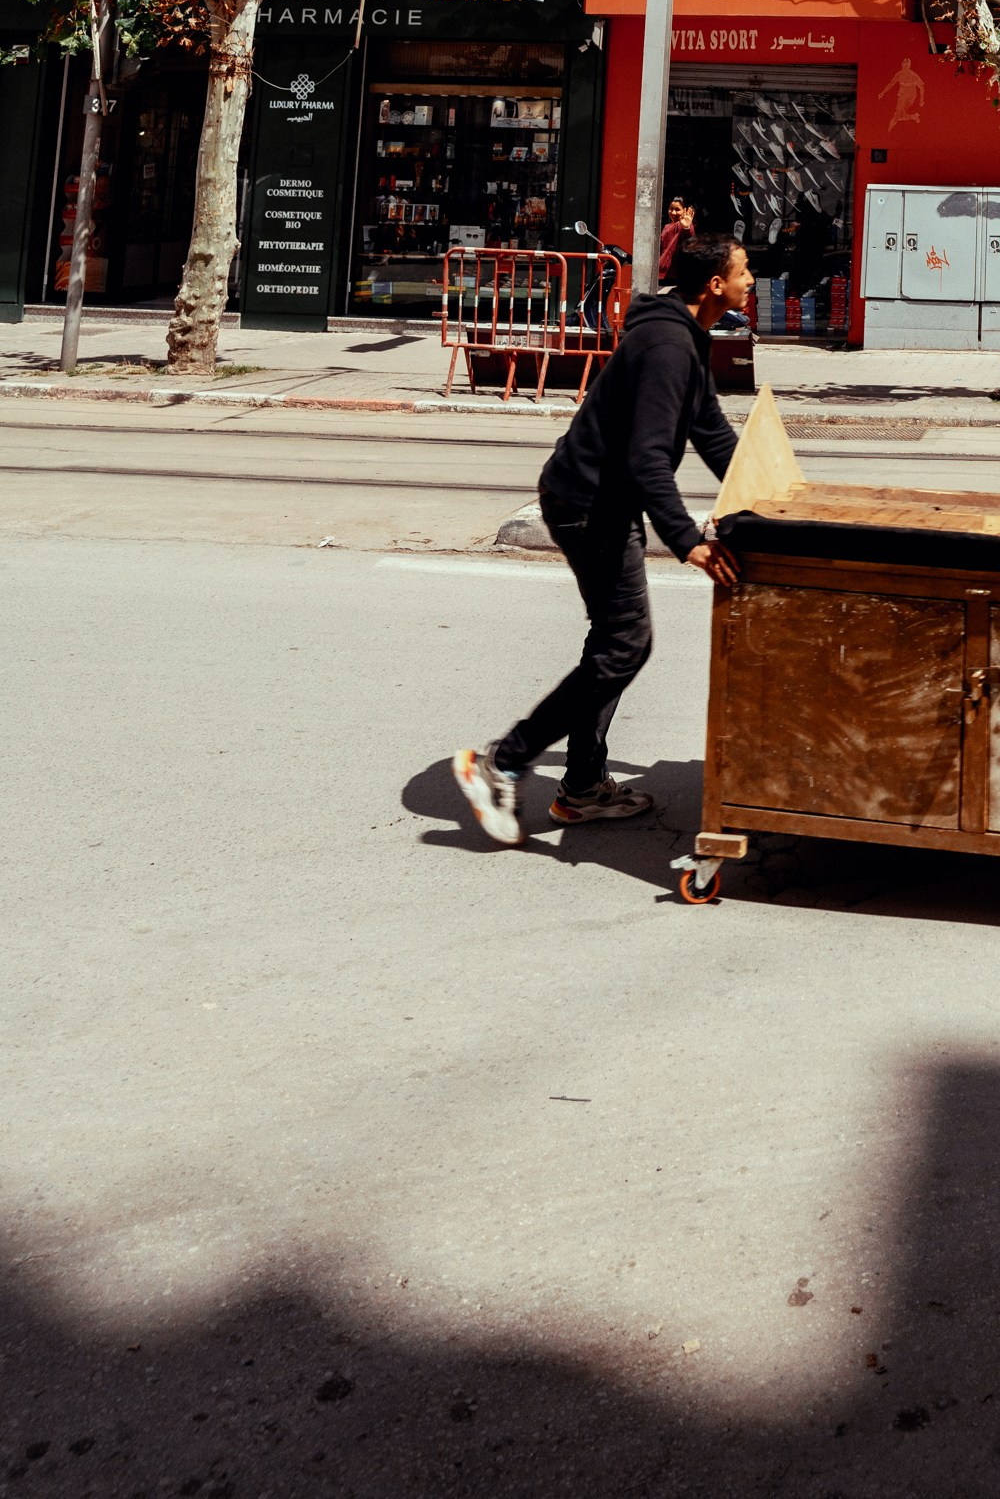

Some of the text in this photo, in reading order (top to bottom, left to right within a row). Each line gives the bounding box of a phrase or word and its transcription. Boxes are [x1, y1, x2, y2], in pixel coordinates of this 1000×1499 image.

[257, 8, 422, 26] HARMACIE
[670, 30, 758, 51] VITA SPORT
[91, 98, 117, 114] 37
[269, 100, 335, 110] LUXURY PHARMA
[280, 179, 312, 188] DERMO
[266, 188, 324, 199] COSMETIQUE
[265, 210, 322, 221] COSMETIQUE
[285, 221, 301, 229] BIO
[258, 240, 324, 251] PHYTOTHERAPIE
[257, 262, 321, 274] HOMÉOPATHIE
[256, 284, 319, 295] ORTHOPEDIE
